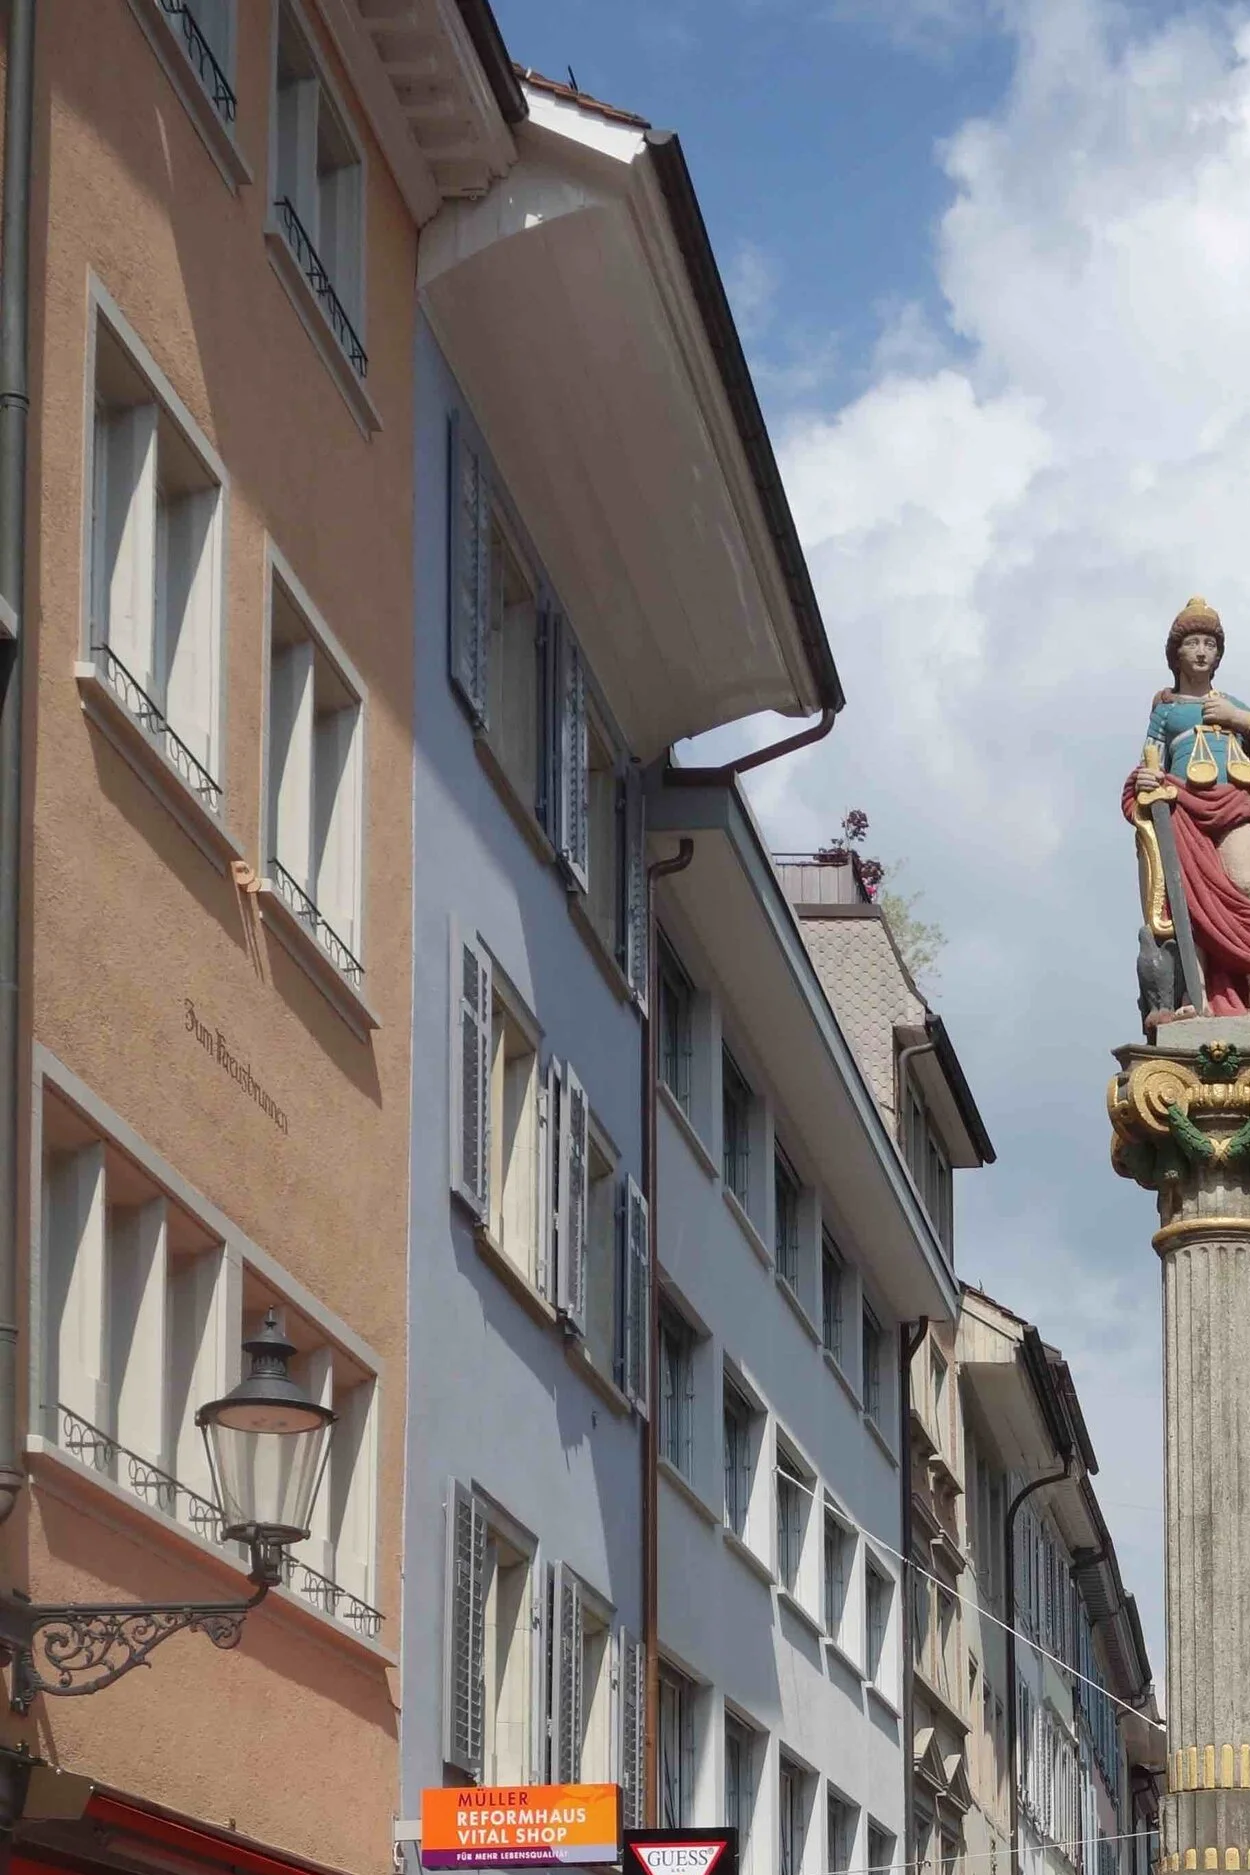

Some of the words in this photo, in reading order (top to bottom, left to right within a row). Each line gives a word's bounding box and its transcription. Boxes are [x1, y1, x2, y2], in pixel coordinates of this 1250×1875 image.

[184, 998, 214, 1056] Zum
[458, 1788, 529, 1807] MÜLLER
[457, 1808, 587, 1827] REFORMHAUS
[457, 1829, 509, 1845] VITAL
[515, 1827, 568, 1844] SHOP
[456, 1851, 473, 1861] FÜR
[475, 1851, 498, 1861] MEHR
